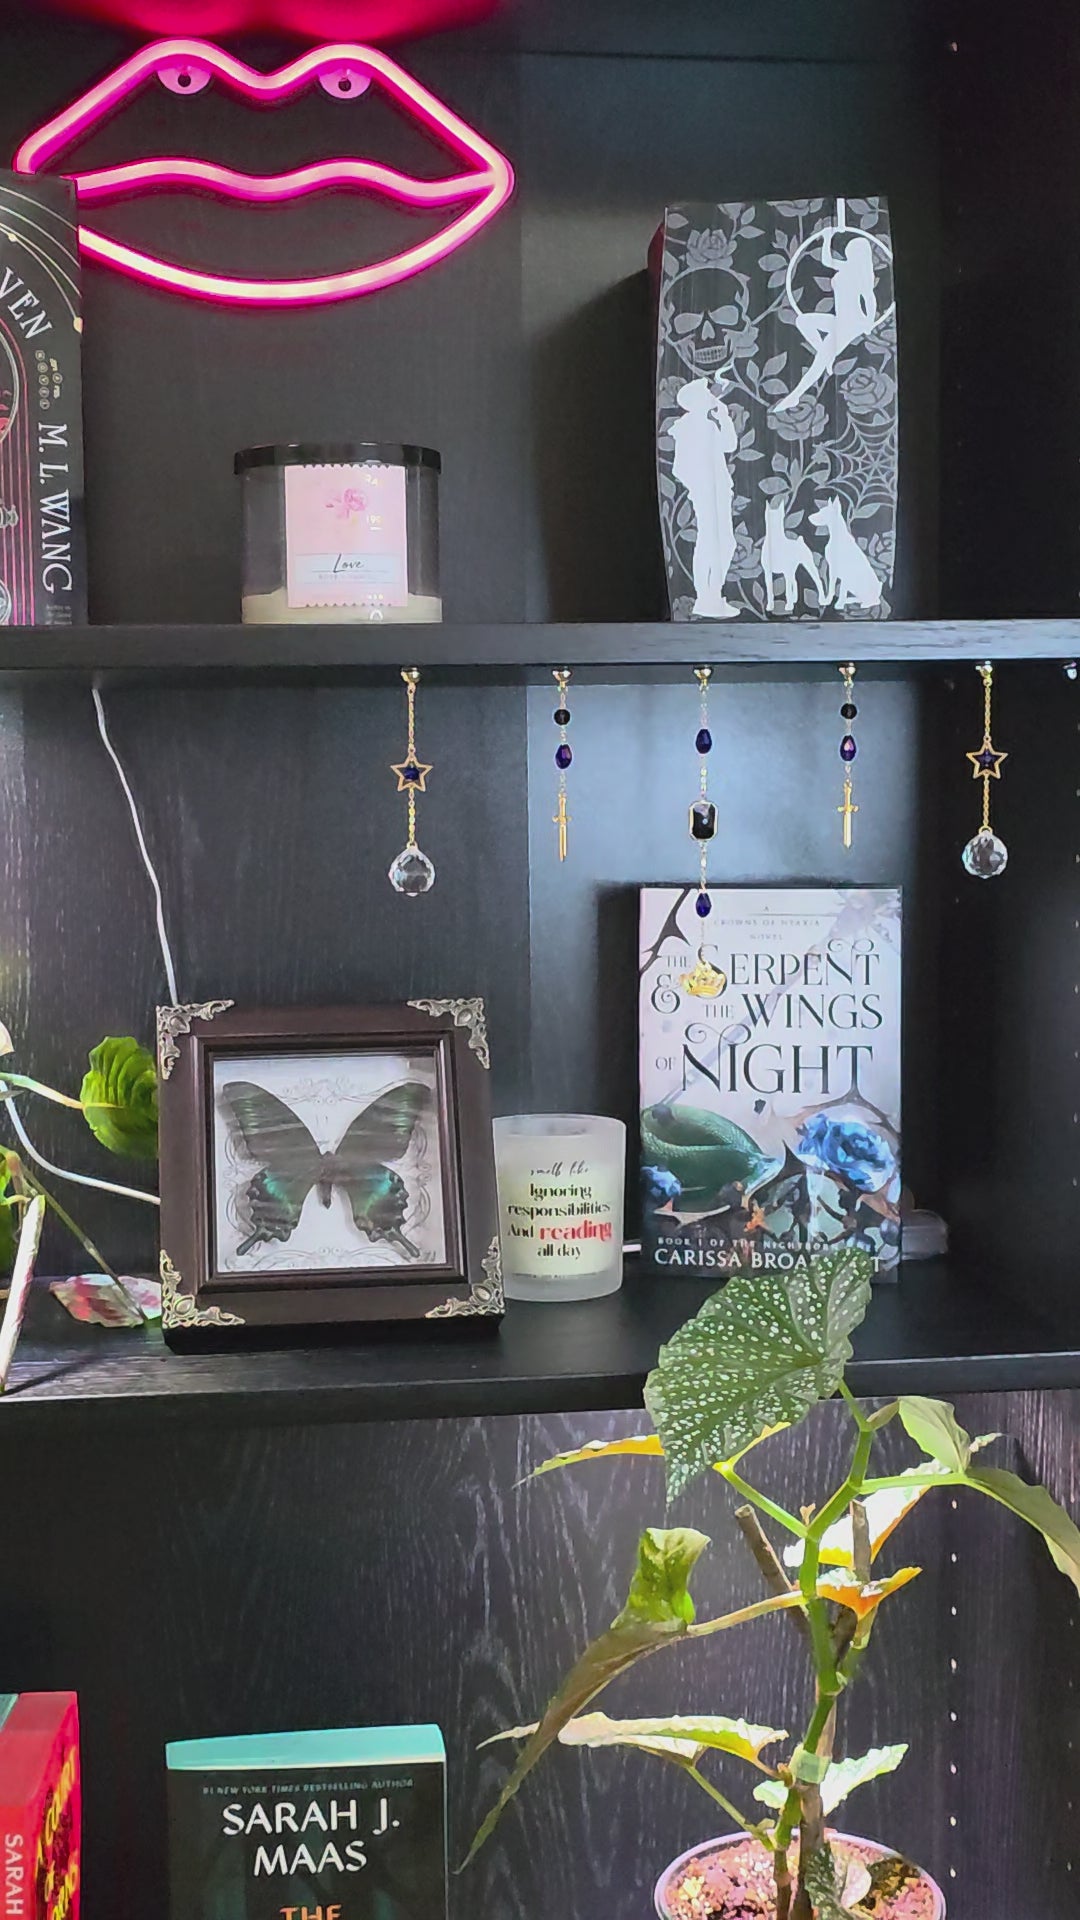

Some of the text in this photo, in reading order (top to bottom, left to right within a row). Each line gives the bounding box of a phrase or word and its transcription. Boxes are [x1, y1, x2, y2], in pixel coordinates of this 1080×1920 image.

[38, 422, 68, 454] M.
[38, 462, 69, 486] L.
[39, 488, 73, 595] WANG
[332, 553, 365, 573] Love
[666, 938, 880, 999] THE SERPENT
[651, 973, 883, 1030] & THE WINGS
[655, 1022, 874, 1094] OF NIGHT
[530, 1183, 592, 1201] Ignoring
[507, 1201, 611, 1221] responsibilities
[507, 1219, 613, 1242] And reading
[657, 1236, 691, 1246] BOOK
[709, 1238, 725, 1247] OF
[732, 1239, 757, 1248] THE
[537, 1243, 581, 1260] all day
[654, 1248, 742, 1269] CARISSA
[217, 1785, 239, 1795] NEW
[242, 1785, 268, 1795] YORK
[271, 1784, 300, 1794] TIMES
[303, 1780, 368, 1793] BESTSELLING
[371, 1778, 414, 1789] AUTHOR
[222, 1797, 400, 1836] SARAH J.
[253, 1840, 368, 1878] MAAS
[5, 1833, 24, 1915] SARAH
